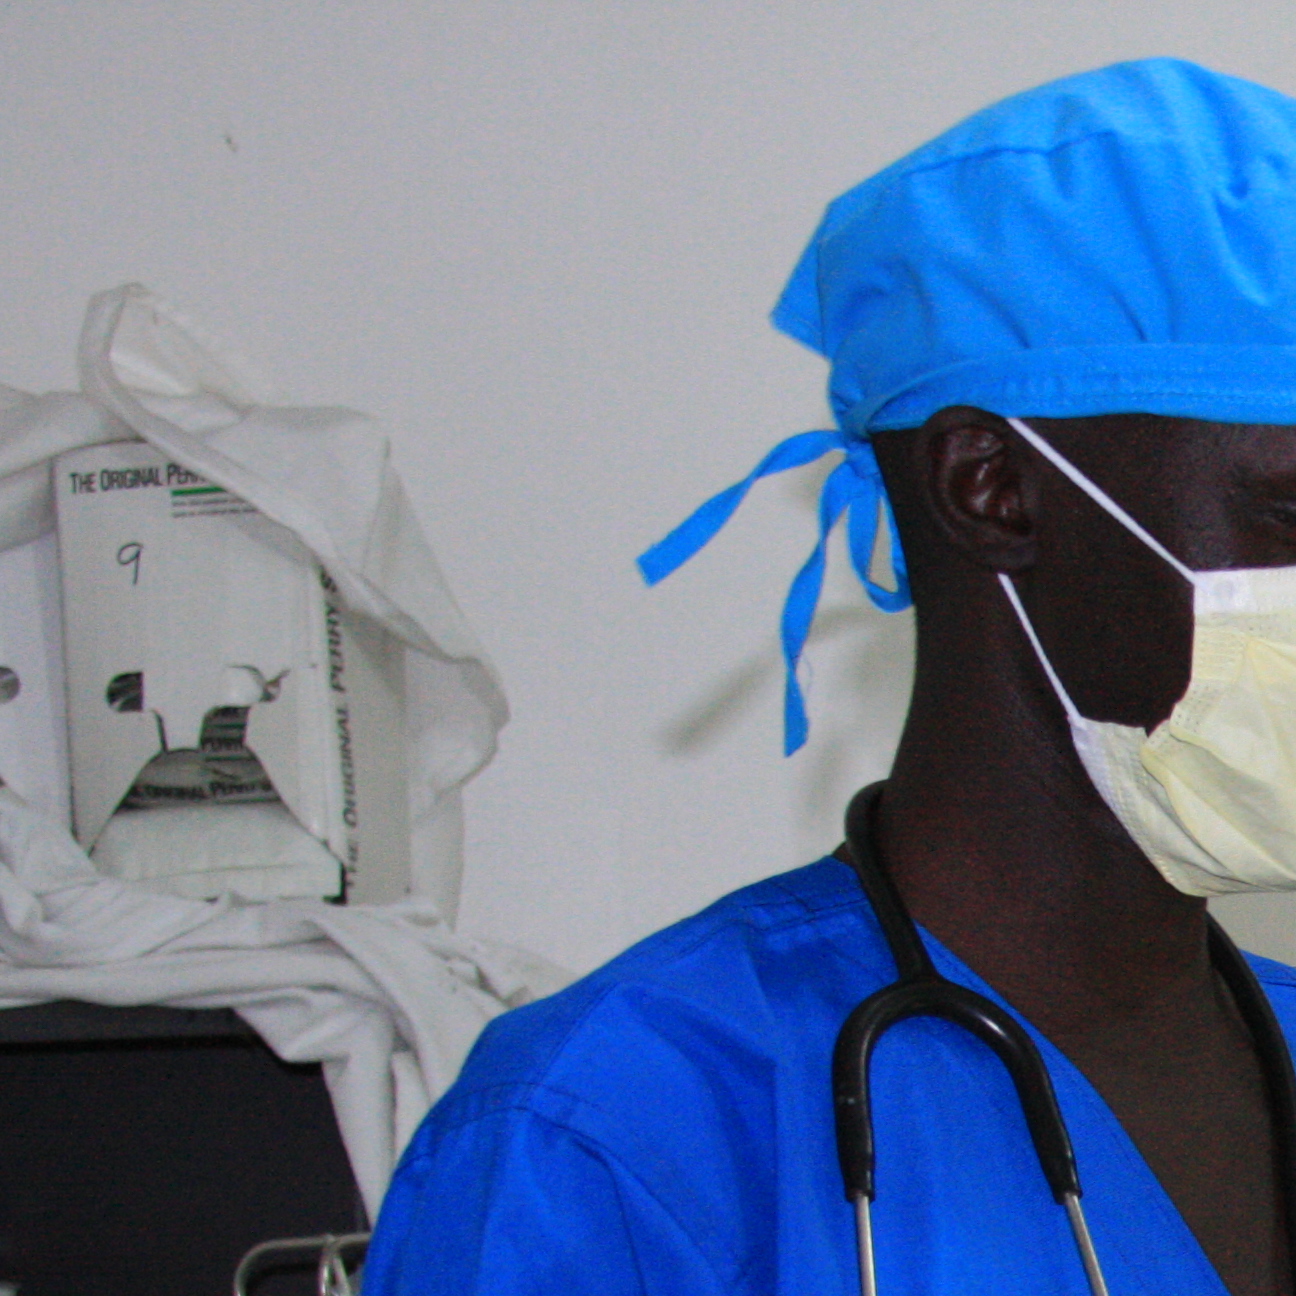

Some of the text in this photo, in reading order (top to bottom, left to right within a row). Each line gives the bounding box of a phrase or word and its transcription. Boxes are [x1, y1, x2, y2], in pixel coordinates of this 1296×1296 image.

[69, 472, 97, 494] THE
[100, 466, 164, 492] ORIGINAL
[116, 541, 144, 586] 9
[325, 604, 347, 694] PERRY
[336, 704, 359, 829] ORIGINAL
